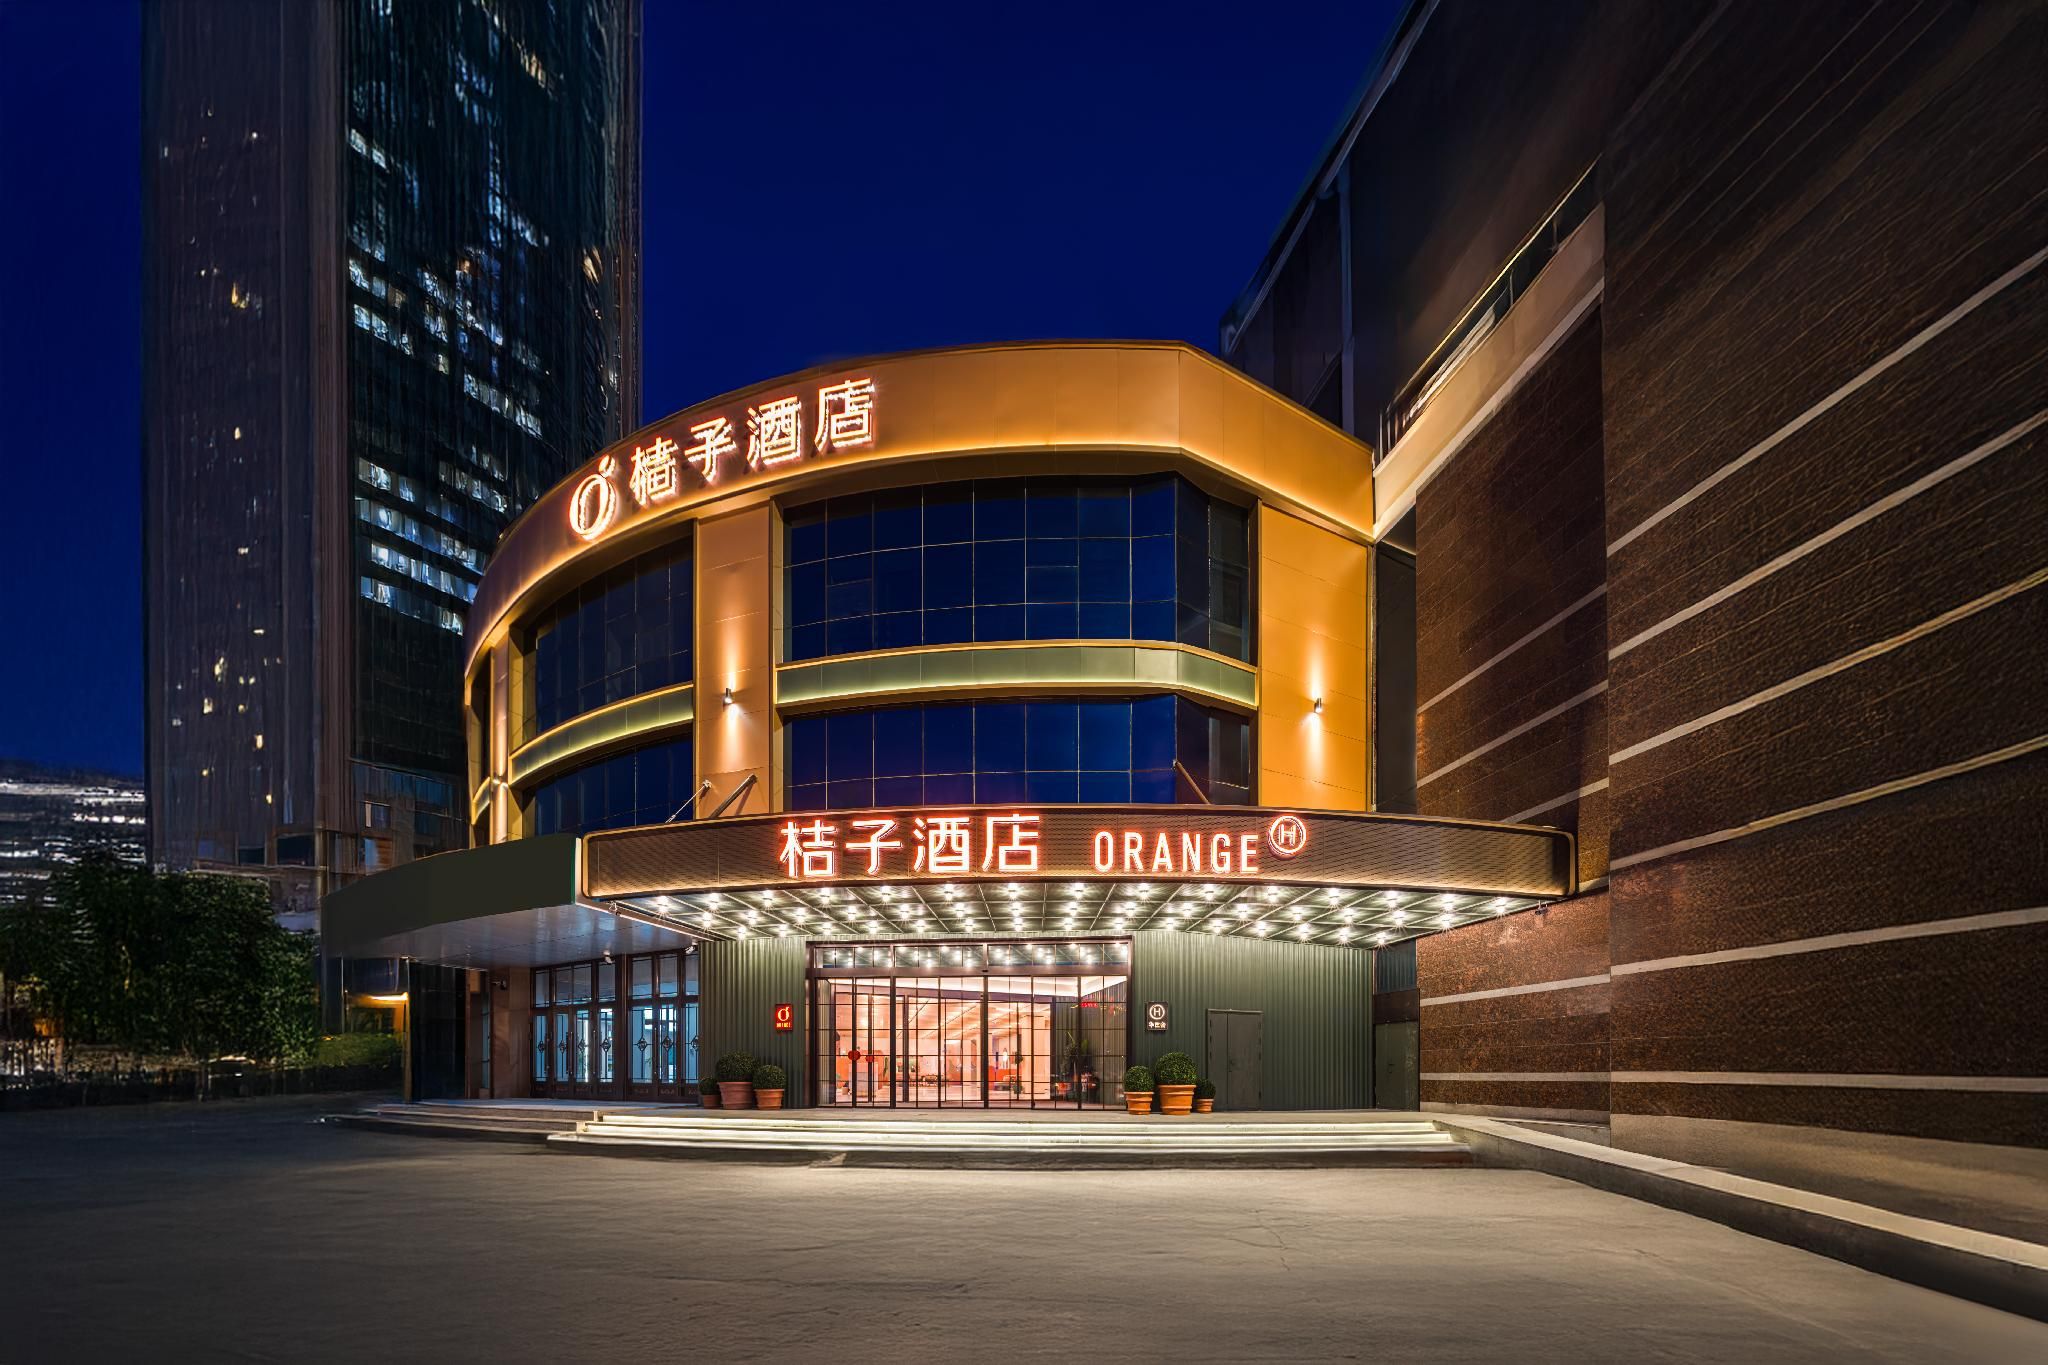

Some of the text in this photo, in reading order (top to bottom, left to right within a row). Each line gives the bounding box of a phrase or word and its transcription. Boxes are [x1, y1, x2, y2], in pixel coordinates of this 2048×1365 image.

[630, 378, 875, 506] 桔子酒店
[780, 814, 1040, 878] 桔子酒店
[1094, 831, 1259, 874] ORANGE
